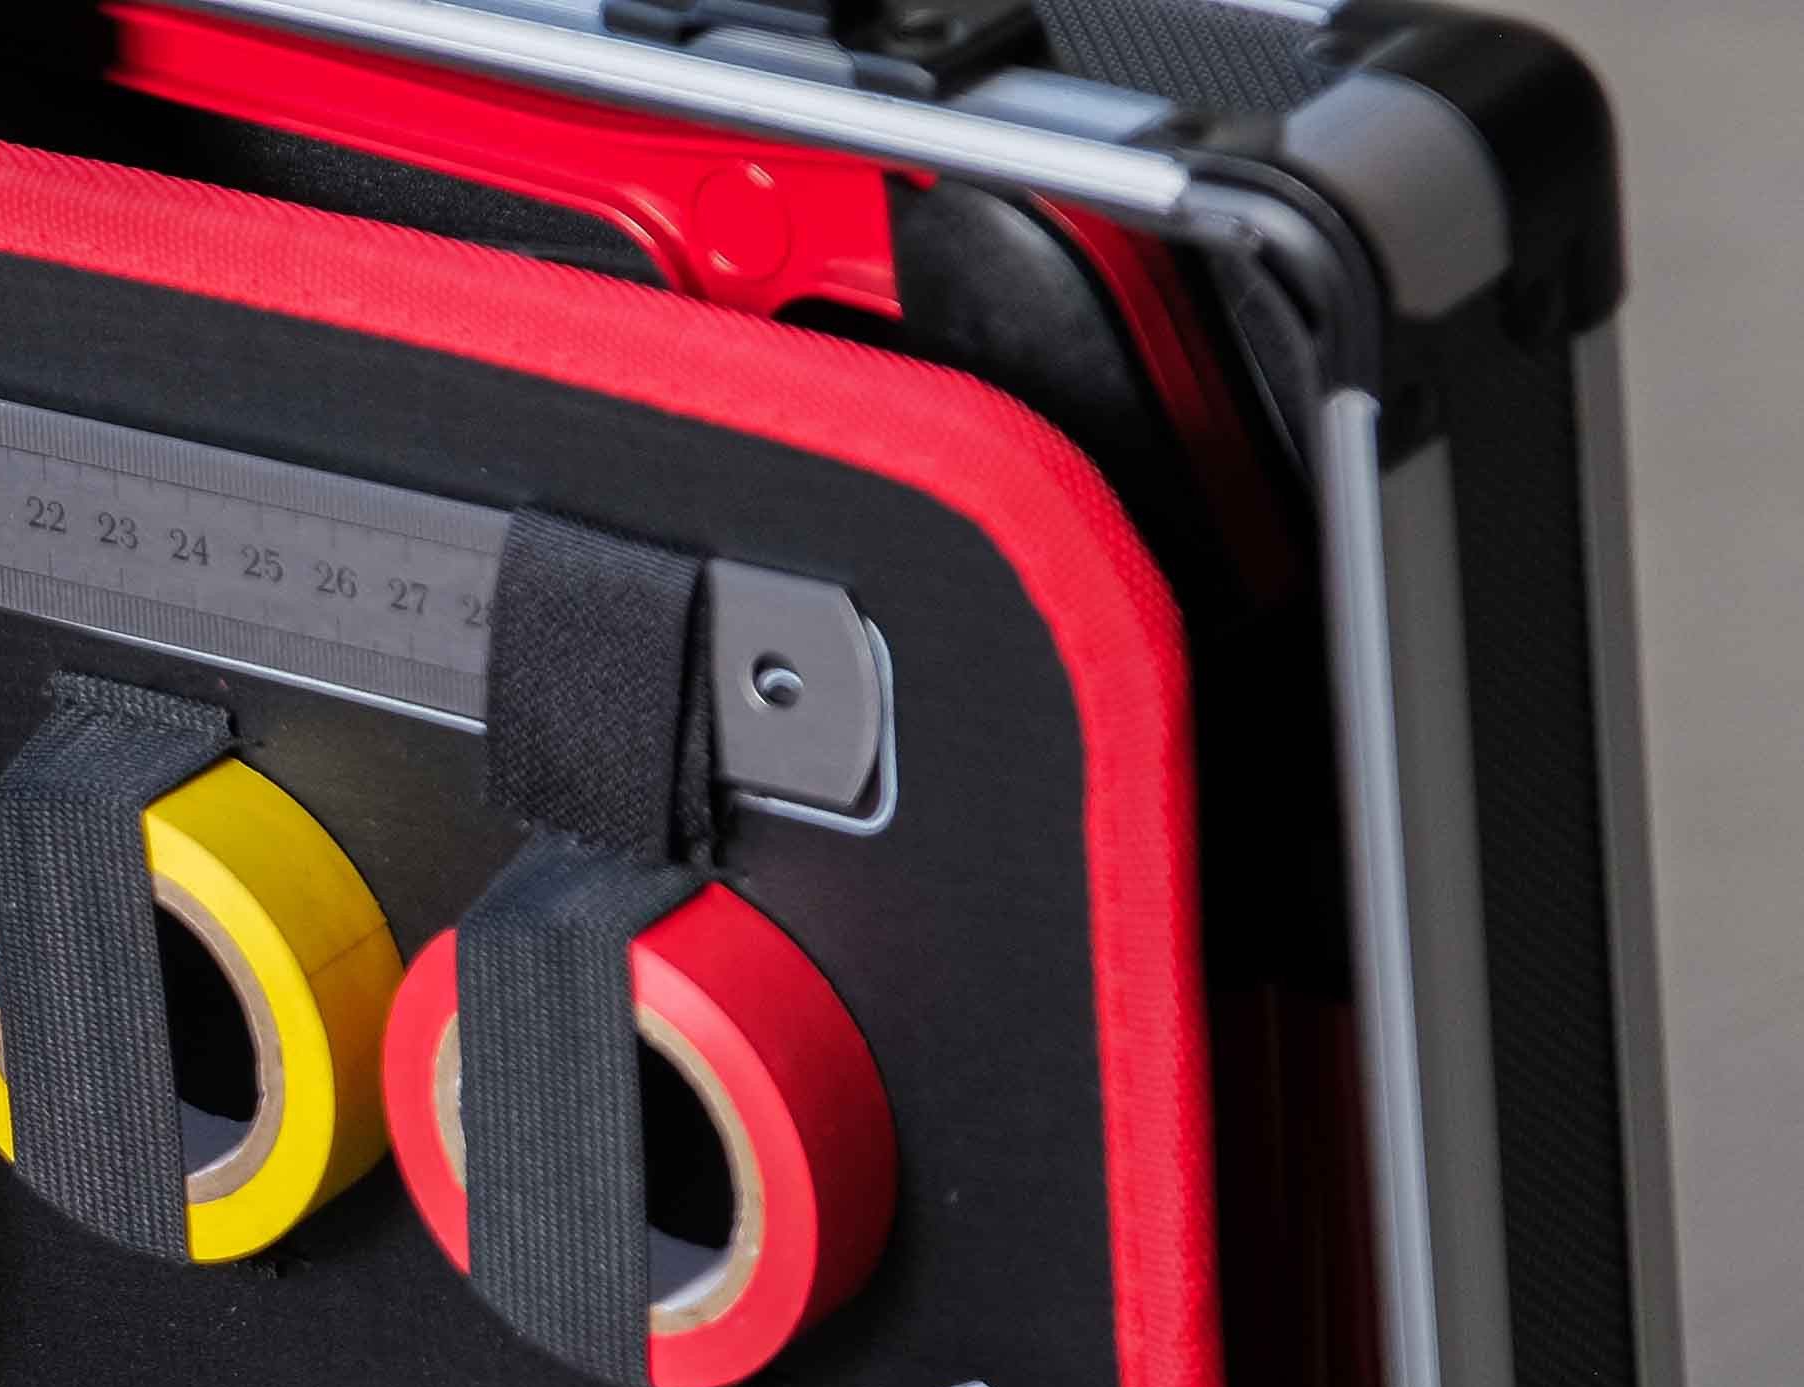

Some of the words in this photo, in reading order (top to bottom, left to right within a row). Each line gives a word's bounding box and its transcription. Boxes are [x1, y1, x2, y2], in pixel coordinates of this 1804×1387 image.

[26, 495, 67, 534] 22
[97, 511, 139, 550] 23
[168, 528, 211, 567] 24
[240, 545, 285, 583] 25
[313, 560, 359, 599] 26
[388, 577, 430, 616] 27
